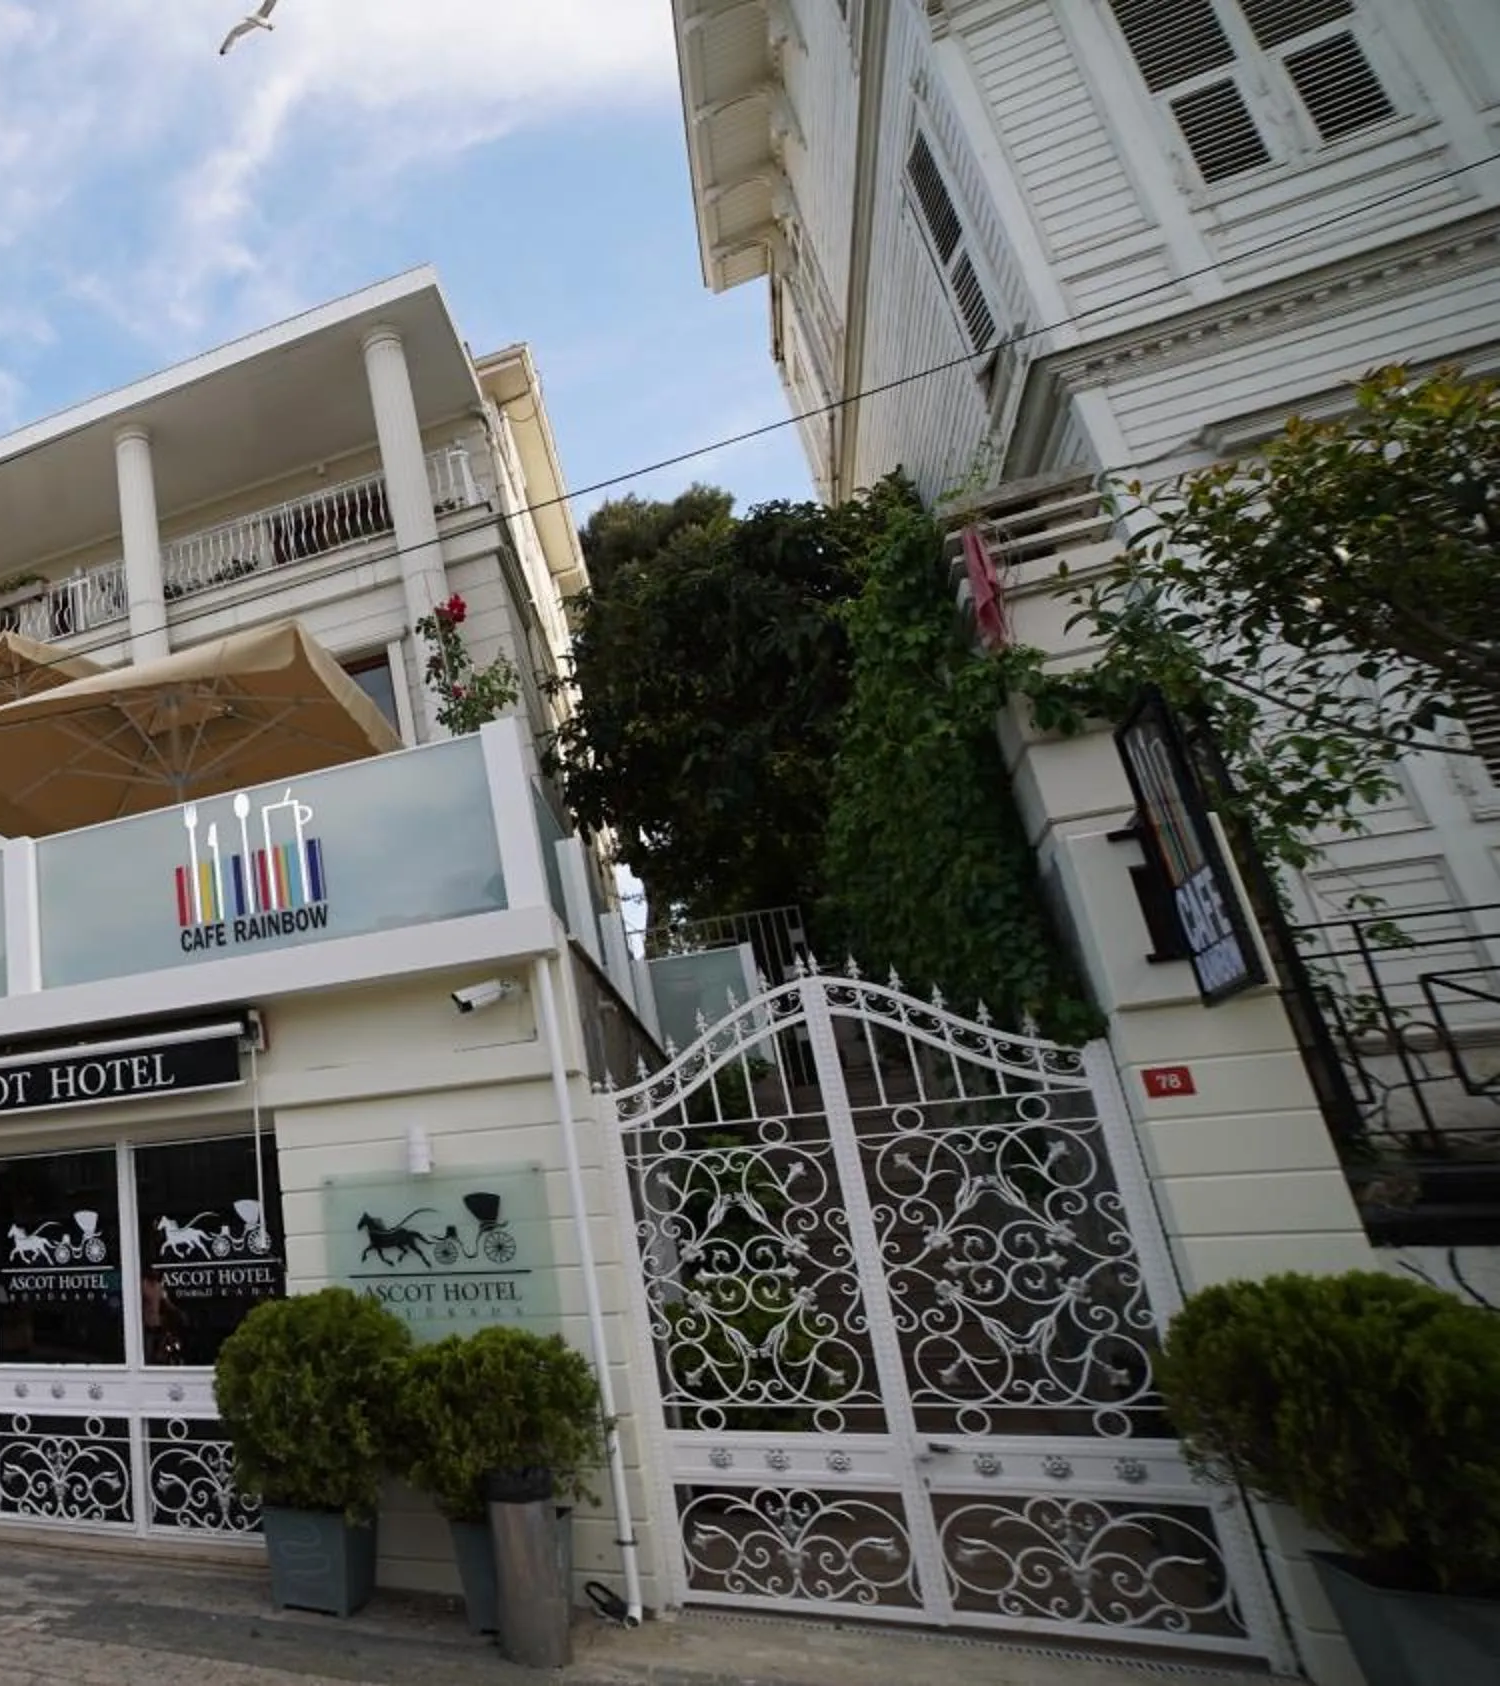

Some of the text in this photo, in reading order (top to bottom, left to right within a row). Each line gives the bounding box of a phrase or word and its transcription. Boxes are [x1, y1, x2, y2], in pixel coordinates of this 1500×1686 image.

[1176, 866, 1233, 953] CAFE
[180, 904, 329, 952] CAFE RAINBOW
[50, 1053, 175, 1099] HOTEL
[9, 1274, 109, 1291] ASCOT HOTEL
[162, 1267, 276, 1287] ASCOT HOTEL
[364, 1281, 523, 1303] ASCOT HOTEL
